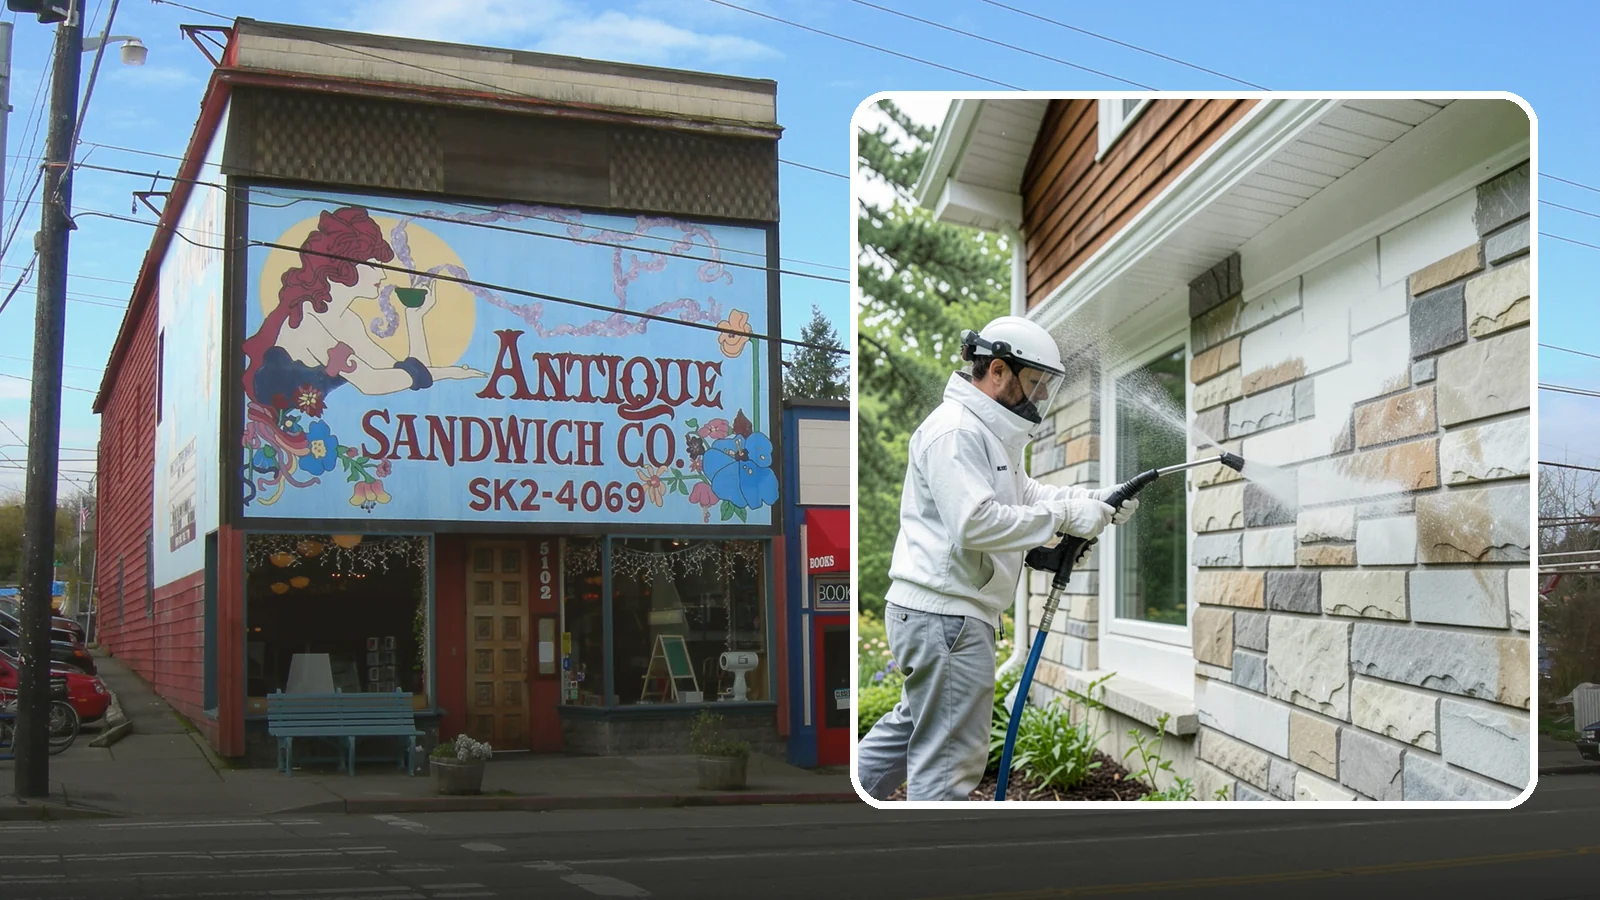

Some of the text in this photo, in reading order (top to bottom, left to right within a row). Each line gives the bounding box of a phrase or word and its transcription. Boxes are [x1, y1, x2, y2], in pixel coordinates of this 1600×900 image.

[475, 328, 723, 420] ANTIQUE
[361, 408, 684, 468] SANDWICH CO.
[468, 477, 645, 513] SK2-4069
[540, 541, 551, 600] 5102
[809, 555, 835, 569] BOOKS
